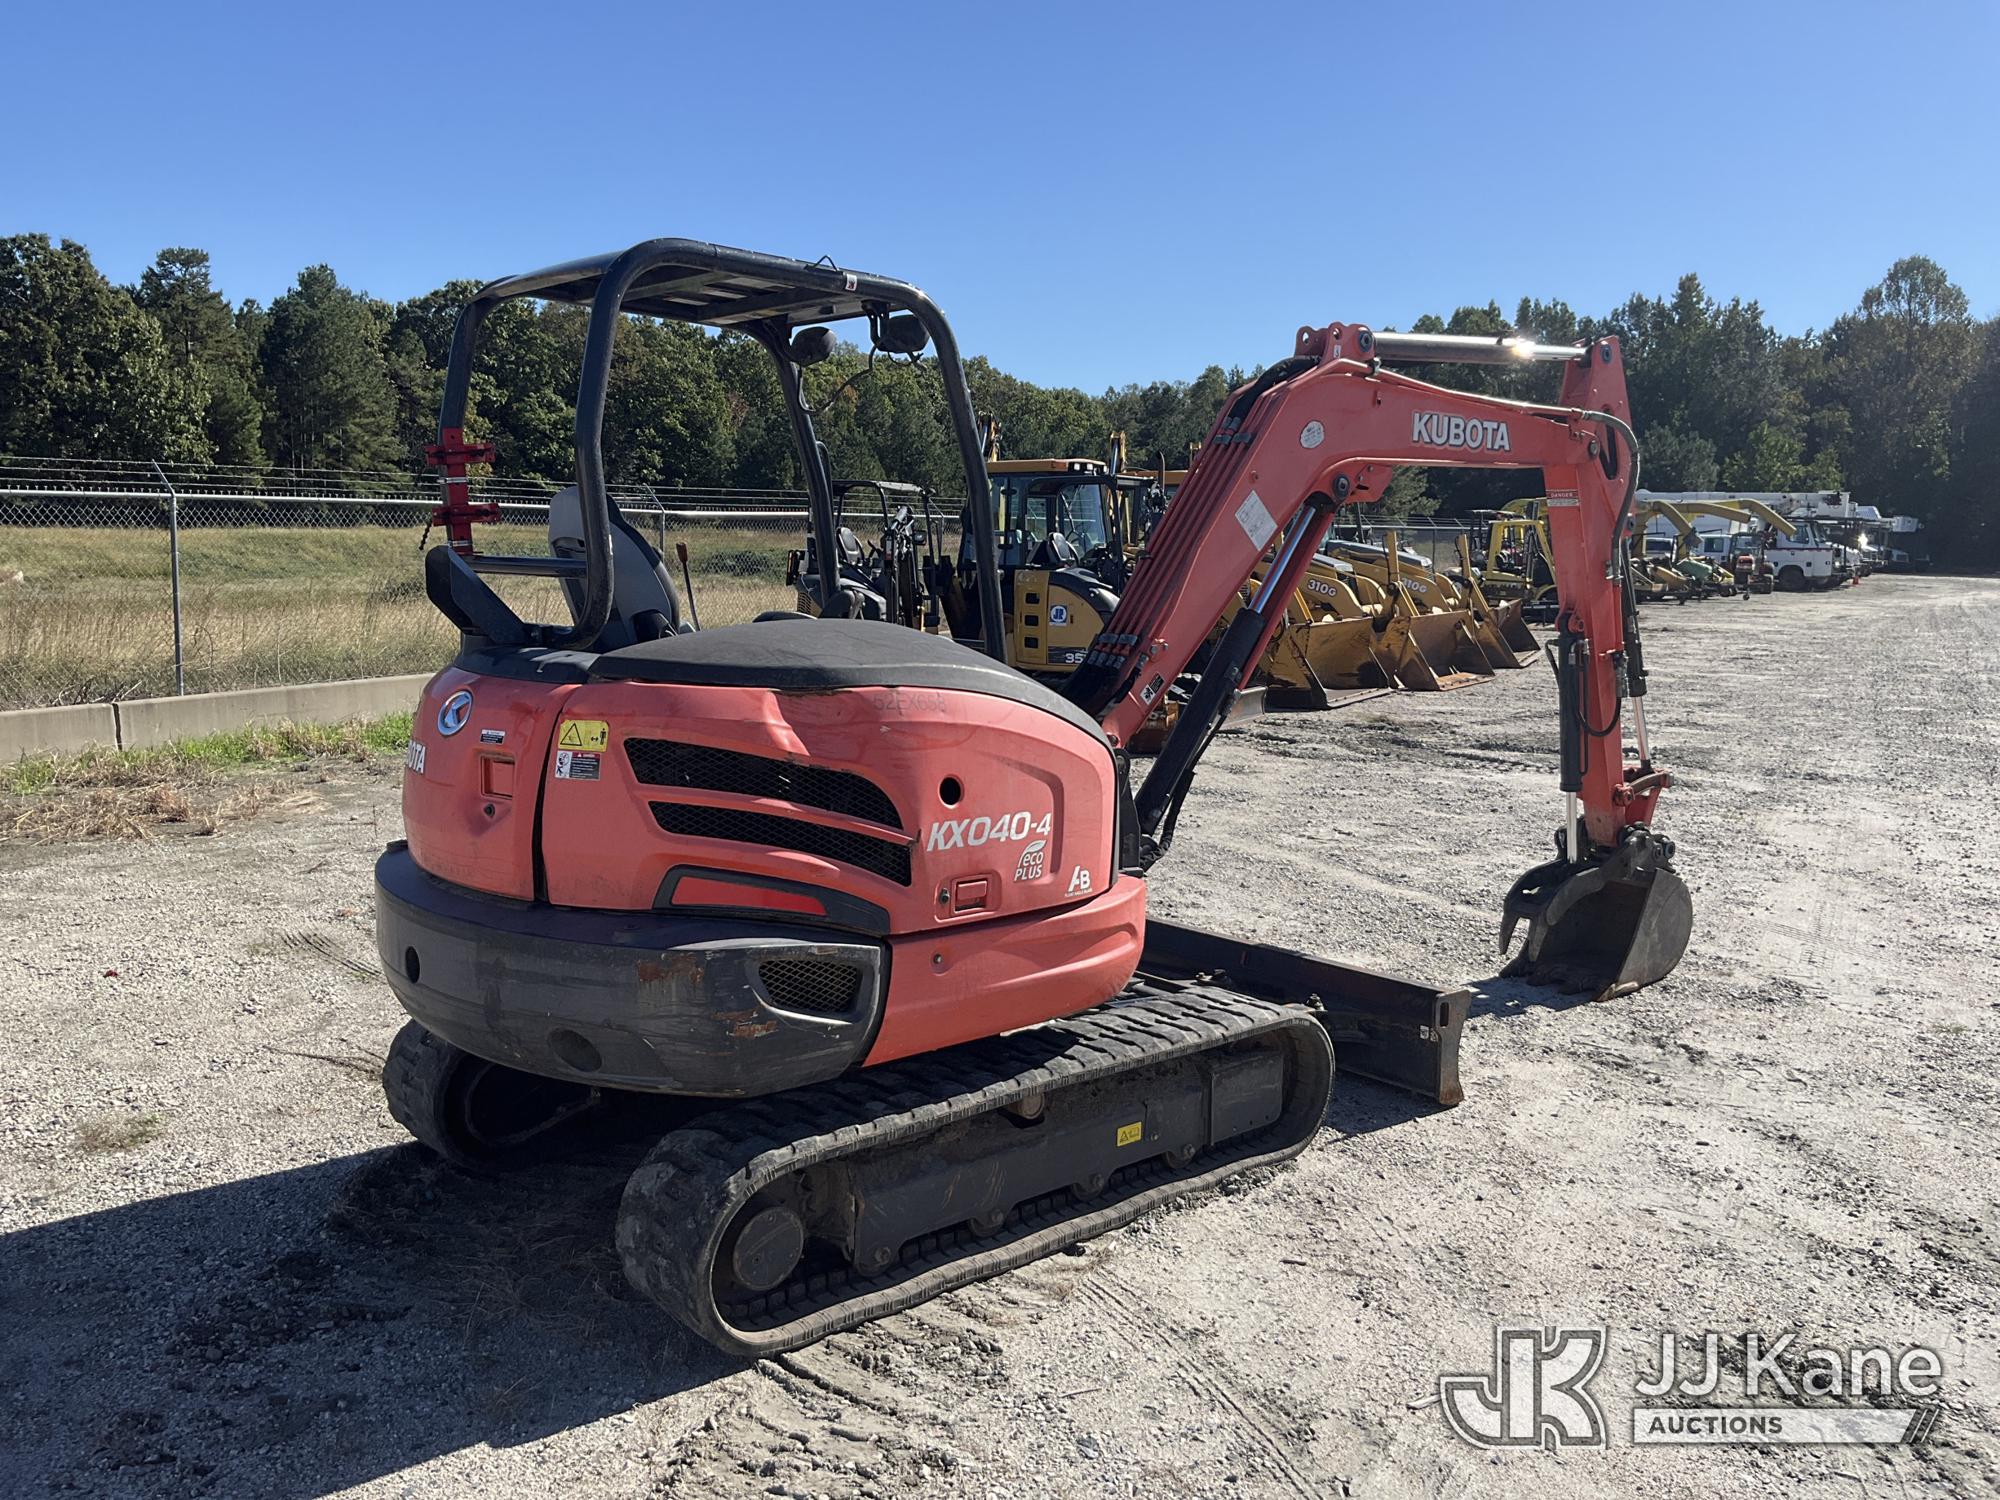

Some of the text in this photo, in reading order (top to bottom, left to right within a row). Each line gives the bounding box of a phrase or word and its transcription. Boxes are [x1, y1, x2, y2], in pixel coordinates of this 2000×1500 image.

[1412, 411, 1511, 451] KUBOTA
[1307, 579, 1337, 597] 310G
[1065, 652, 1086, 664] 35
[406, 740, 426, 774] OTA
[926, 811, 1052, 851] KX040-4
[1021, 851, 1044, 866] eco
[1013, 864, 1043, 882] PLUS
